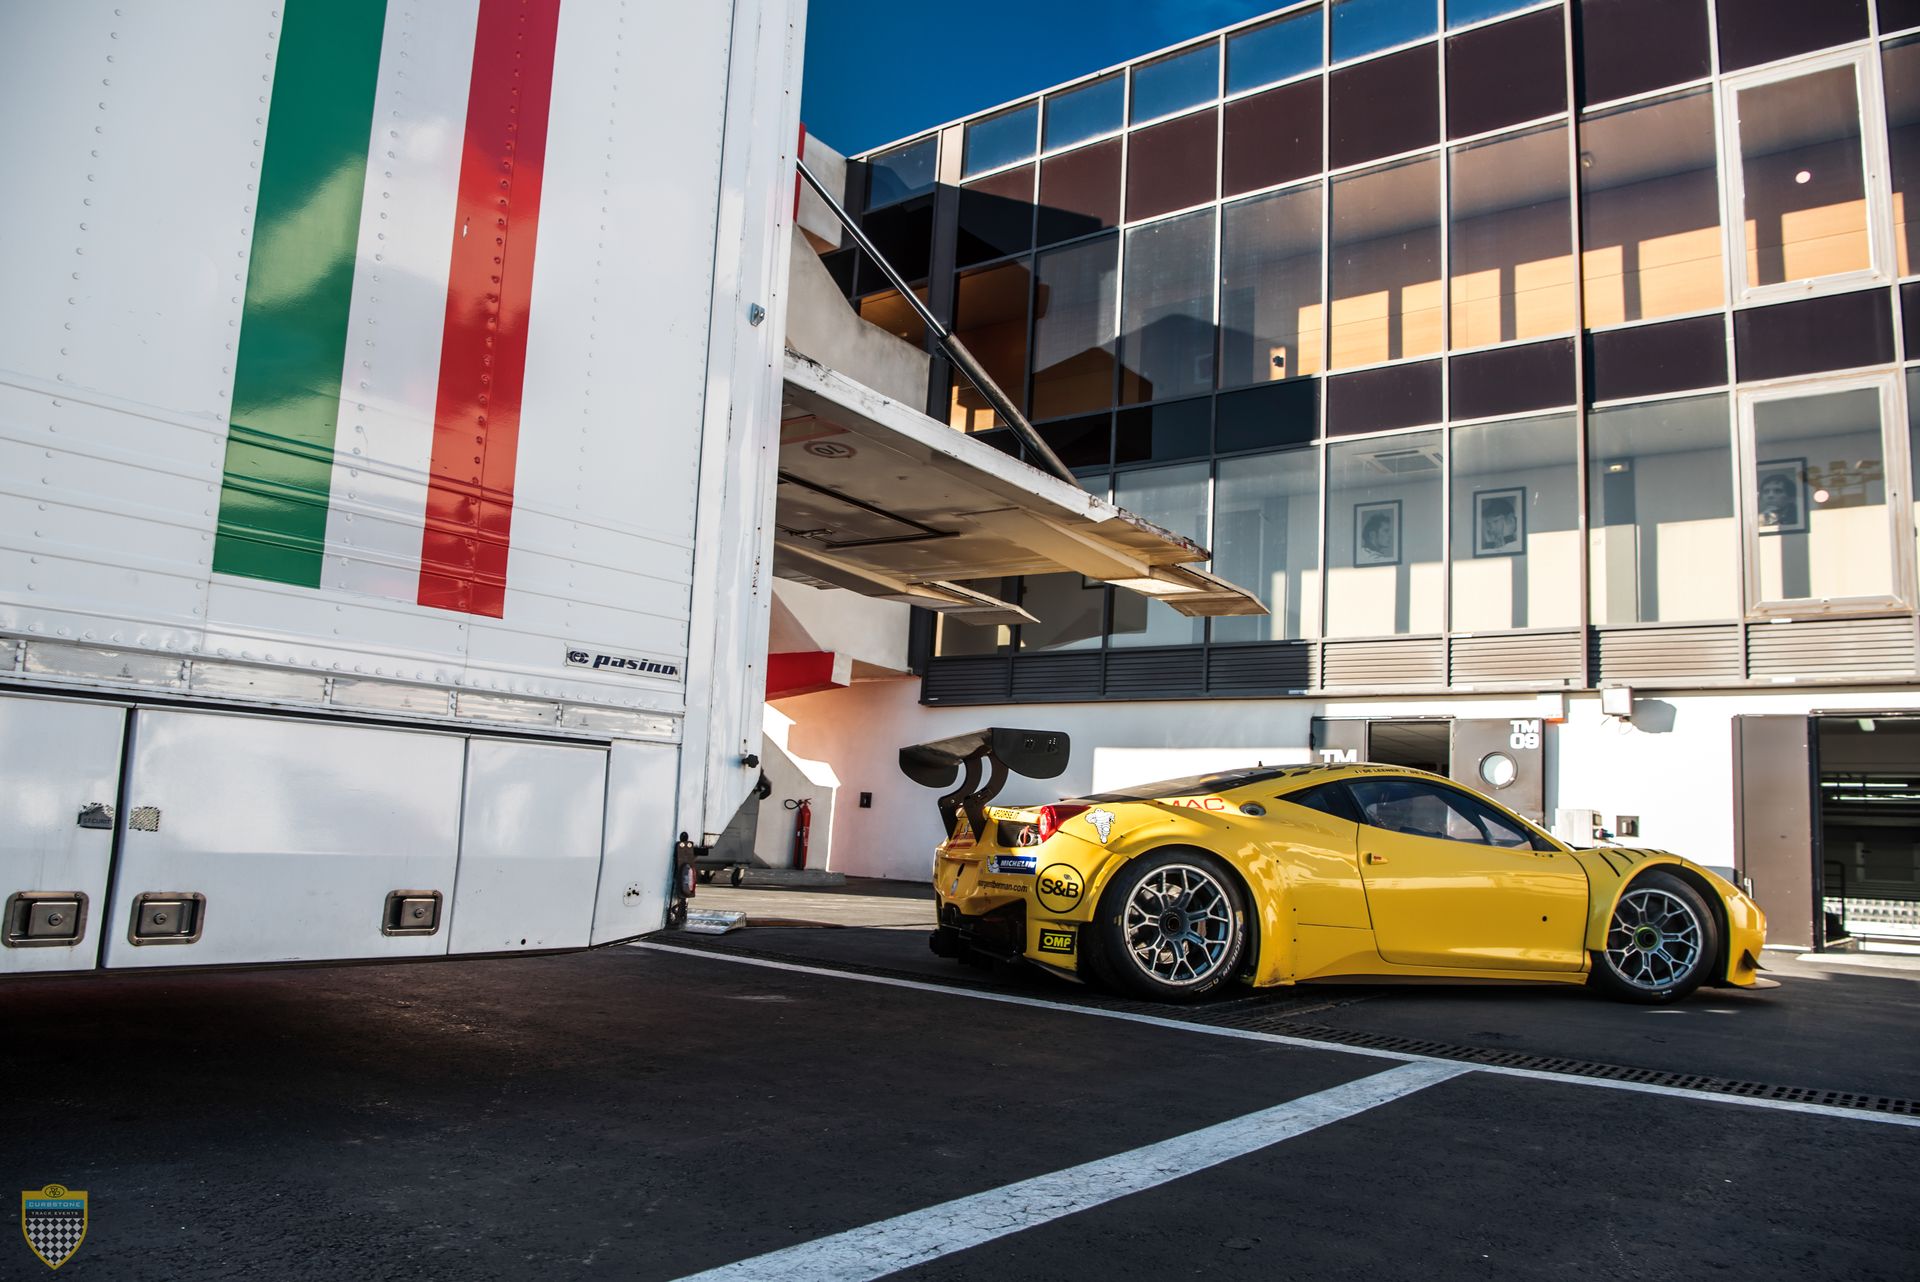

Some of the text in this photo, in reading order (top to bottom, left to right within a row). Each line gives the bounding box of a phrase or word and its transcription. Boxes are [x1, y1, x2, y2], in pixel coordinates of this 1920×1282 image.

[593, 654, 678, 675] pasino
[1510, 720, 1539, 733] TM
[1319, 749, 1357, 763] TM
[1000, 859, 1037, 868] MICHELIN
[1041, 878, 1079, 898] S&B
[1043, 936, 1072, 948] OMP
[1222, 931, 1244, 977] MICHELIN
